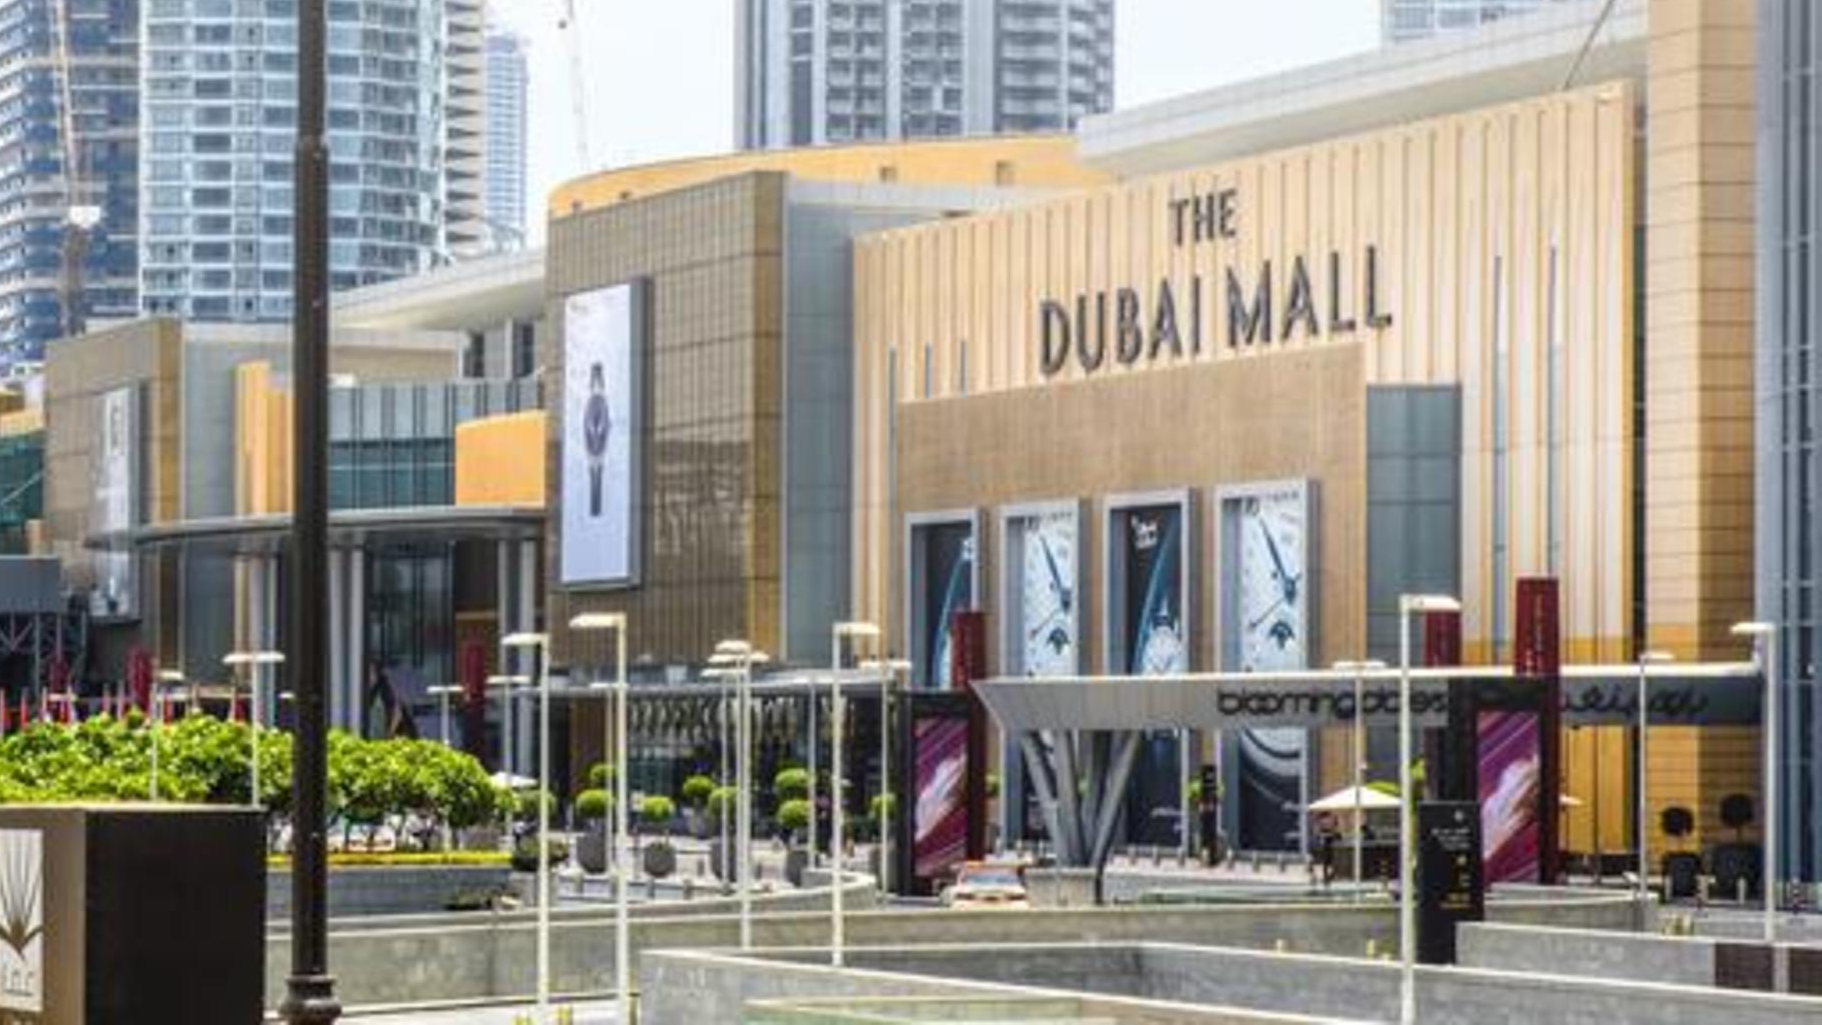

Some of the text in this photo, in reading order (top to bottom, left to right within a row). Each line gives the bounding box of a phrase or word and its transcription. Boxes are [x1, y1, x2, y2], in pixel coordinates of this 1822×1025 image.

[1168, 188, 1238, 247] THE
[1039, 244, 1394, 376] DUBAI MALL
